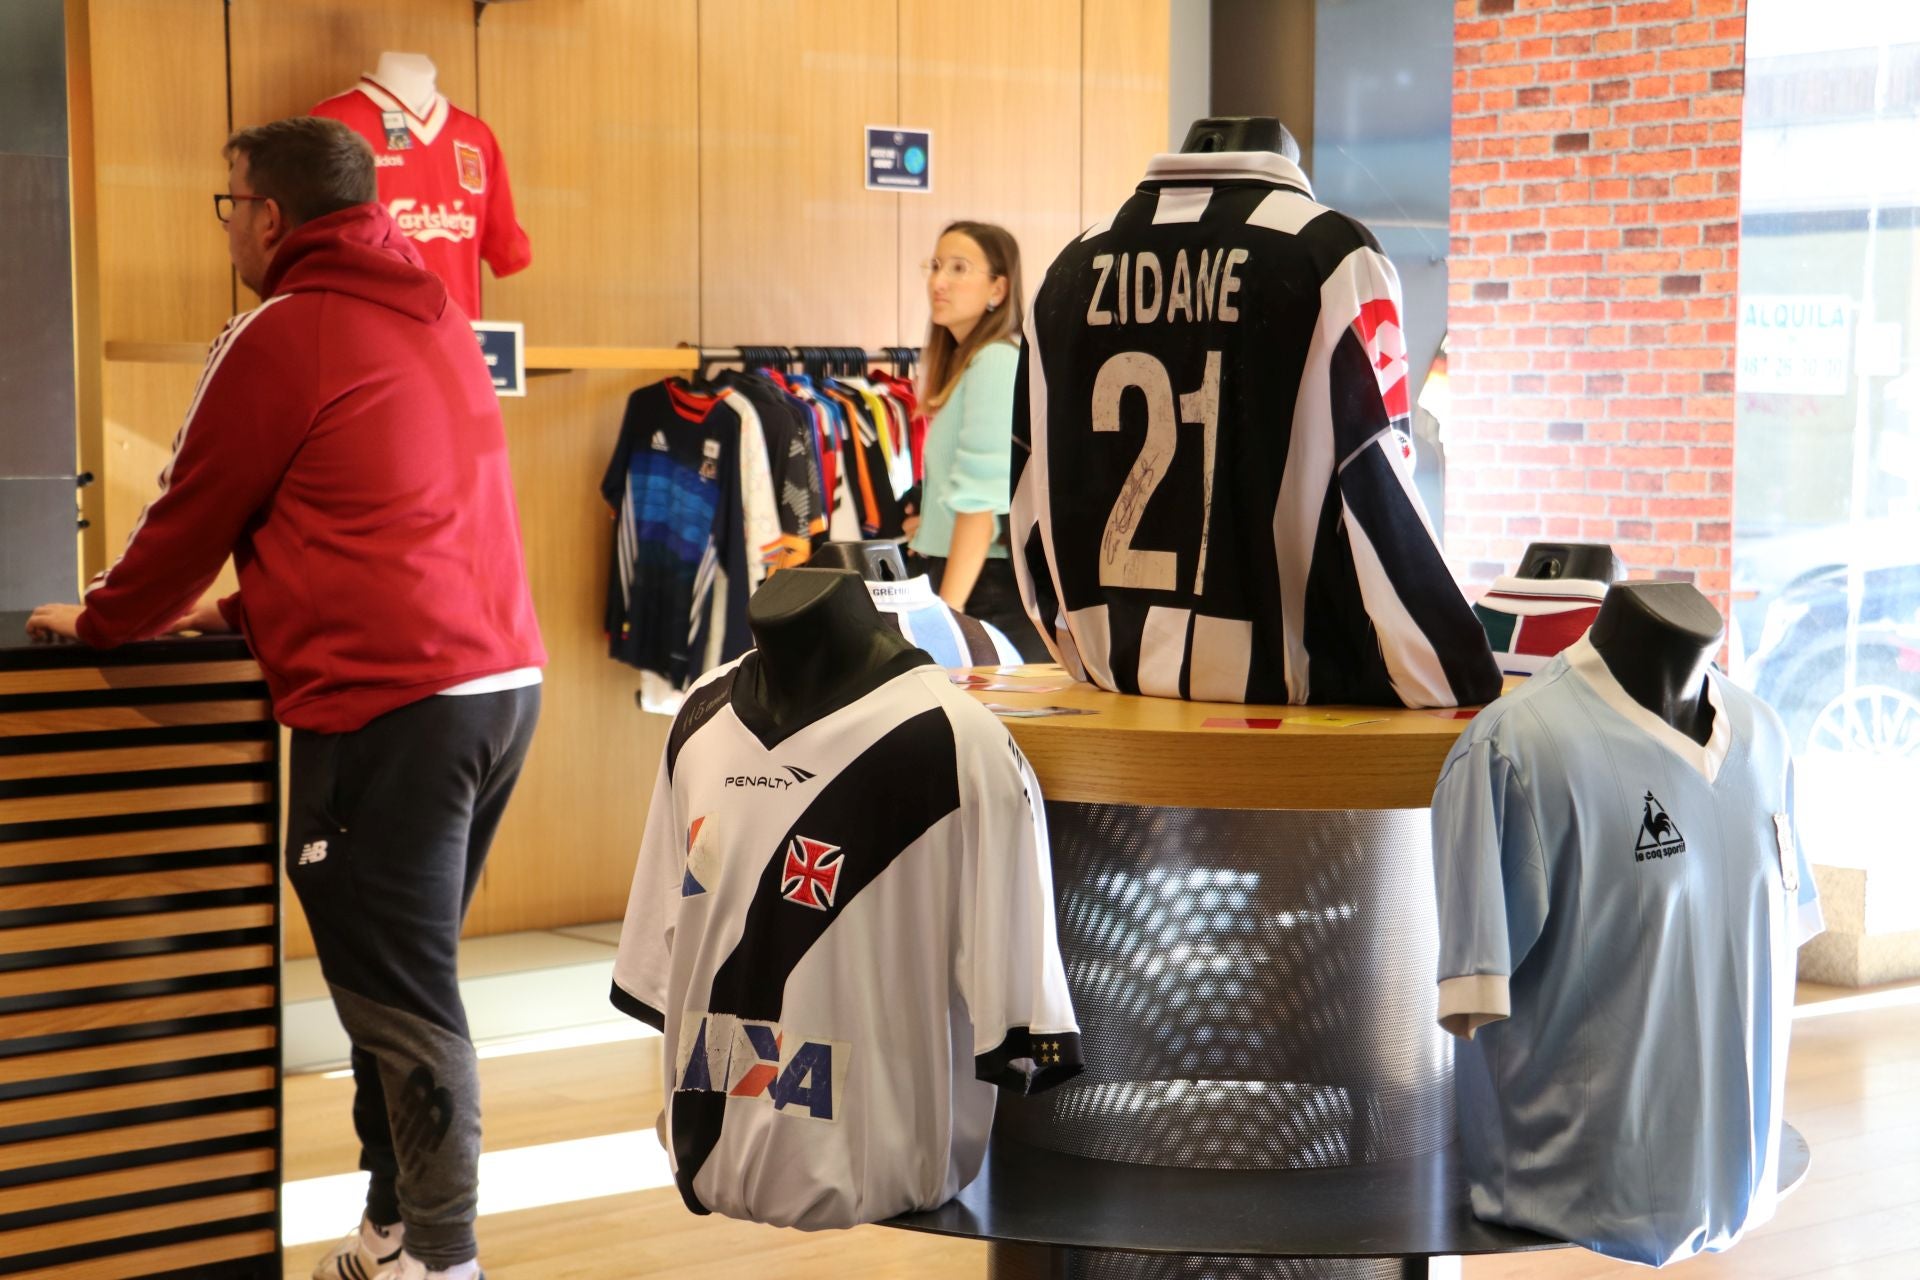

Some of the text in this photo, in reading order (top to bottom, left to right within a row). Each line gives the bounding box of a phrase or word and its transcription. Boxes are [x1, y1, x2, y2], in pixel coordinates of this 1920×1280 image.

[1087, 248, 1249, 326] ZIDANE
[1744, 303, 1844, 328] ALQUILA
[1091, 351, 1222, 596] 21
[725, 775, 793, 790] PENALTY
[1635, 851, 1644, 862] le
[1645, 849, 1662, 860] coq
